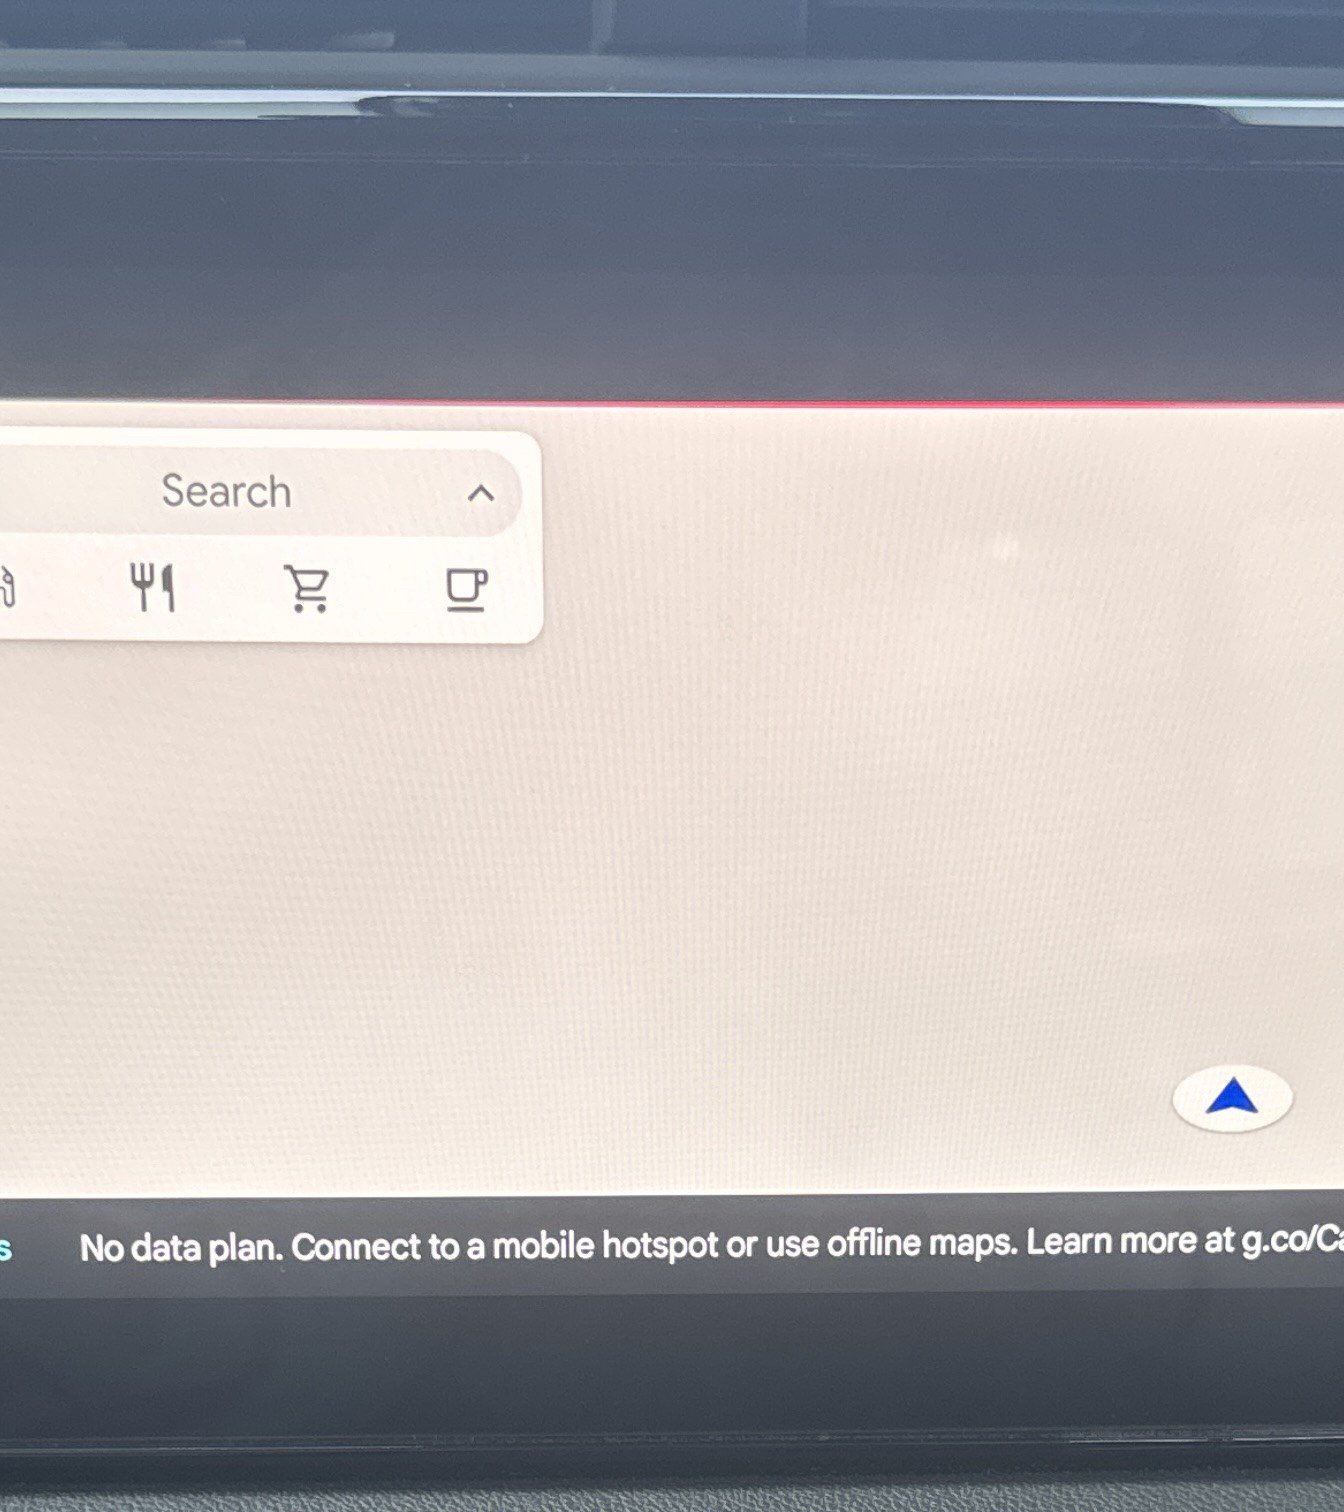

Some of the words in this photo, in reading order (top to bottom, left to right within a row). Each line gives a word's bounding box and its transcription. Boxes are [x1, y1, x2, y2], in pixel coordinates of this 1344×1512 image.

[162, 472, 293, 511] Search
[80, 1234, 124, 1262] No
[131, 1232, 202, 1261] data
[209, 1231, 284, 1268] plan.
[291, 1232, 422, 1261] Connect
[428, 1233, 460, 1260] to
[466, 1237, 485, 1260] a
[493, 1229, 595, 1259] mobile
[603, 1229, 719, 1265] hotspot
[726, 1235, 758, 1258] or
[767, 1234, 820, 1257] use
[827, 1226, 922, 1257] offline
[929, 1231, 1018, 1262] maps.
[1027, 1227, 1112, 1255] Learn
[1120, 1230, 1197, 1254] more
[1205, 1226, 1235, 1252] at
